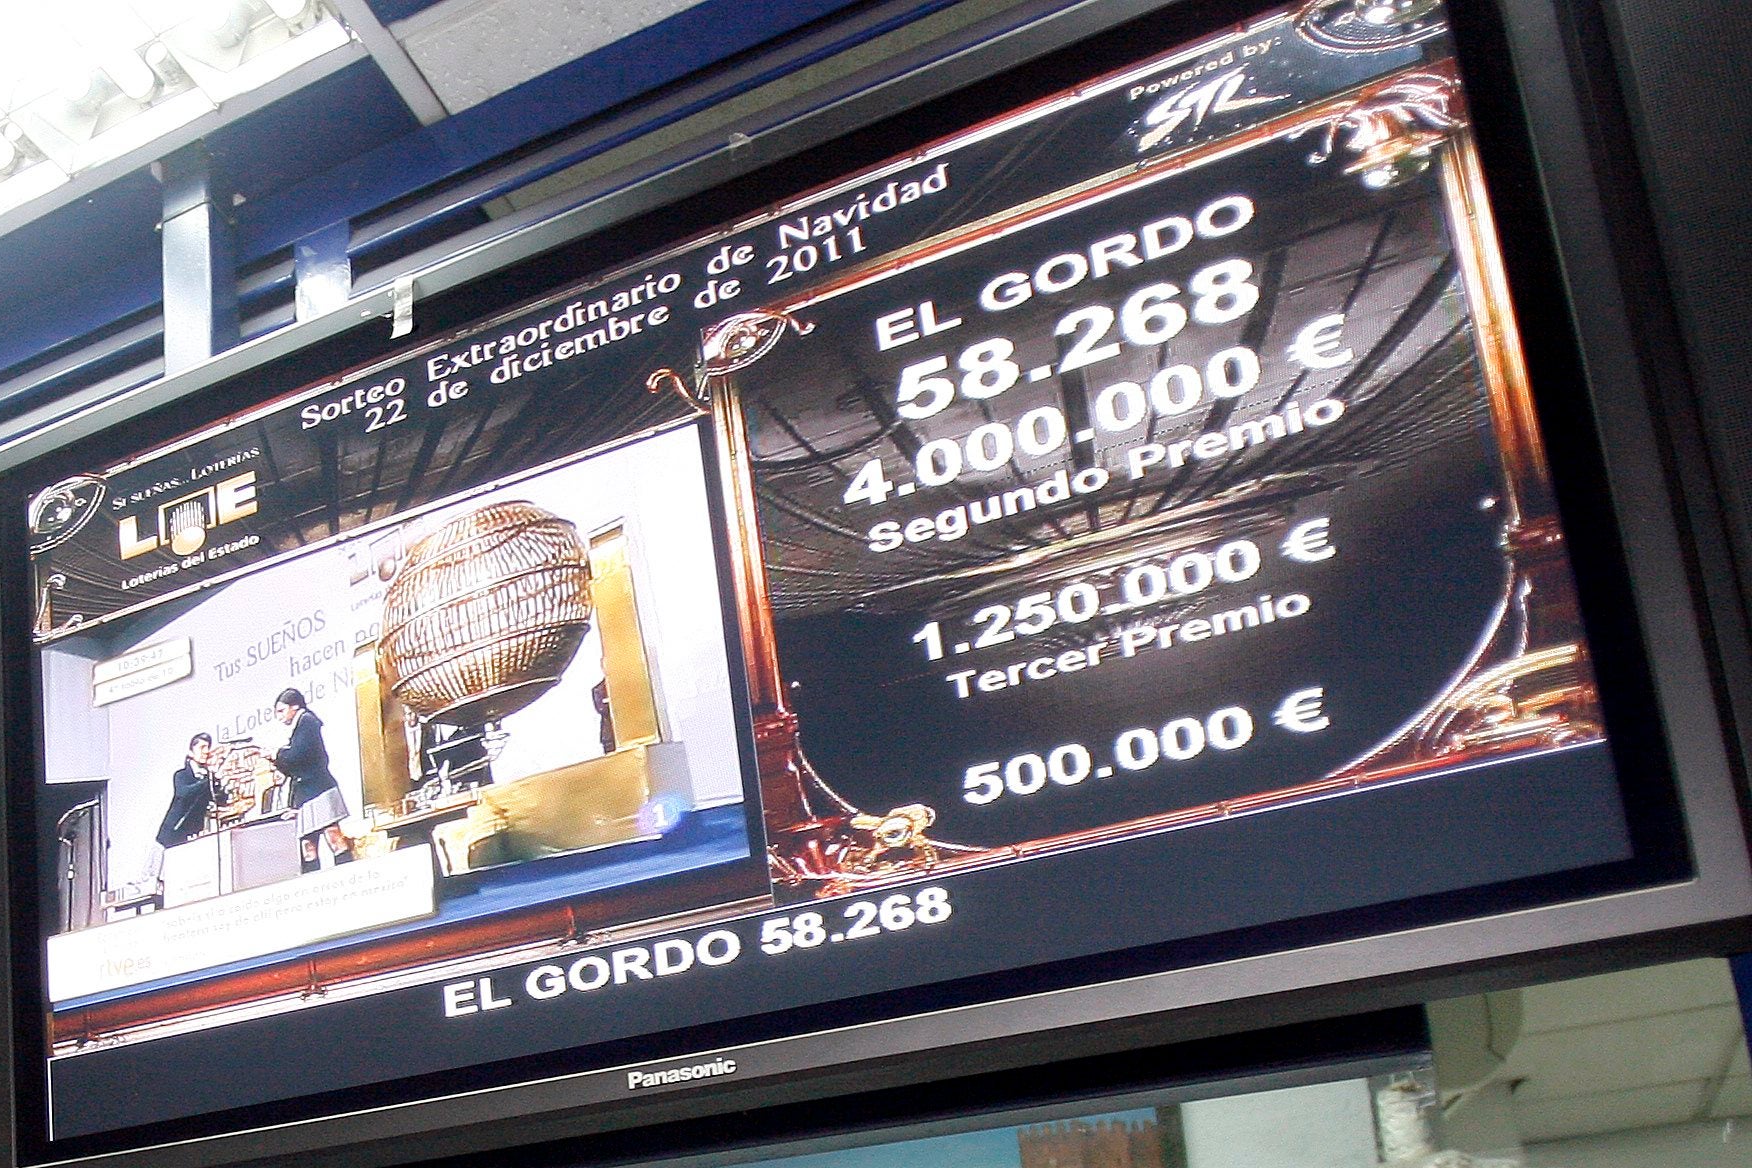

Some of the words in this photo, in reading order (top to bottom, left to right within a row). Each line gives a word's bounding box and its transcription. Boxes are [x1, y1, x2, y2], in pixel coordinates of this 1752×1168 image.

[1129, 52, 1235, 100] Powered
[301, 375, 406, 429] Sorteo
[427, 271, 681, 382] Extraordinario
[707, 245, 753, 275] de
[779, 163, 950, 247] Navidad
[365, 397, 407, 434] 22
[427, 379, 468, 410] de
[490, 304, 668, 386] diciembre
[694, 277, 740, 310] de
[767, 226, 865, 286] 2011
[875, 300, 961, 352] EL
[979, 193, 1254, 311] GORDO
[897, 257, 1260, 421] 58.268
[843, 344, 1259, 505] 4.000.000
[1287, 313, 1354, 370] €
[868, 468, 1110, 553] Segundo
[1130, 399, 1345, 479] Premio
[181, 552, 205, 570] del
[208, 535, 260, 560] Estado
[913, 539, 1262, 662] 1.250.000
[1280, 517, 1337, 563] €
[213, 658, 241, 681] Tus
[247, 610, 325, 666] SUEÑOS
[290, 640, 345, 677] hacen
[946, 637, 1110, 698] Tercer
[1121, 592, 1312, 657] Premio
[962, 706, 1254, 804] 500.000
[1271, 686, 1331, 732] €
[443, 978, 512, 1017] EL
[525, 929, 740, 1000] GORDO
[760, 886, 952, 954] 58.268
[628, 1058, 736, 1090] Panasonic
